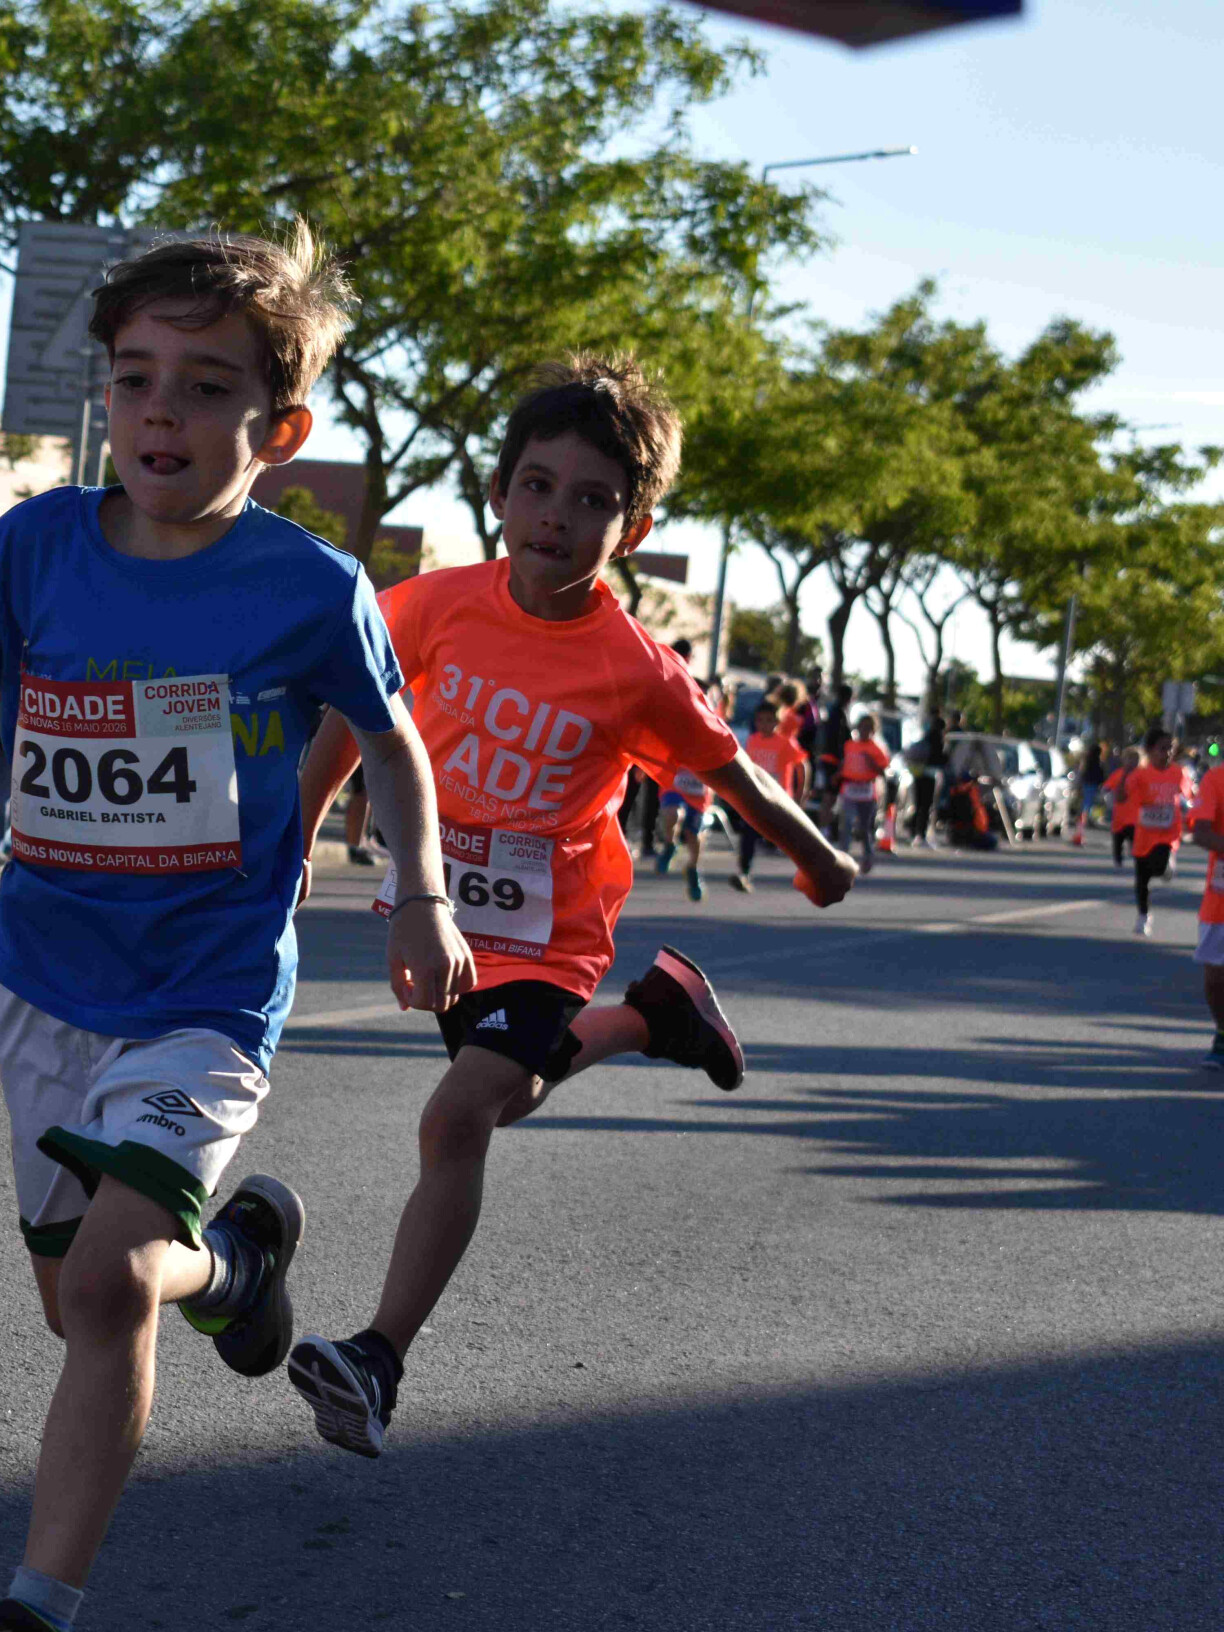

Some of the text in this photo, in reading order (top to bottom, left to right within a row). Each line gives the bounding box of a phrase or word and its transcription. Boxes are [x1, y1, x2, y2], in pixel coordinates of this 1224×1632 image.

[144, 680, 220, 700] CORRIDA
[24, 688, 126, 720] CIDADE
[162, 697, 221, 715] JOVEM
[30, 716, 61, 731] NOVAS
[62, 721, 72, 732] 16
[74, 722, 100, 733] MAIO
[484, 688, 593, 760] CID
[19, 740, 197, 807] 2064
[443, 733, 573, 810] ADE
[439, 771, 498, 812] VENDAS
[40, 806, 166, 824] GABRIEL BATISTA
[440, 823, 485, 854] DADE
[499, 834, 547, 852] CORRIDA
[49, 848, 93, 865] NOVAS
[96, 853, 155, 868] CAPITAL
[159, 854, 180, 868] DA
[183, 849, 237, 867] BIFANA
[509, 847, 547, 860] JOVEM
[465, 936, 491, 950] PITAL
[494, 941, 506, 951] DA
